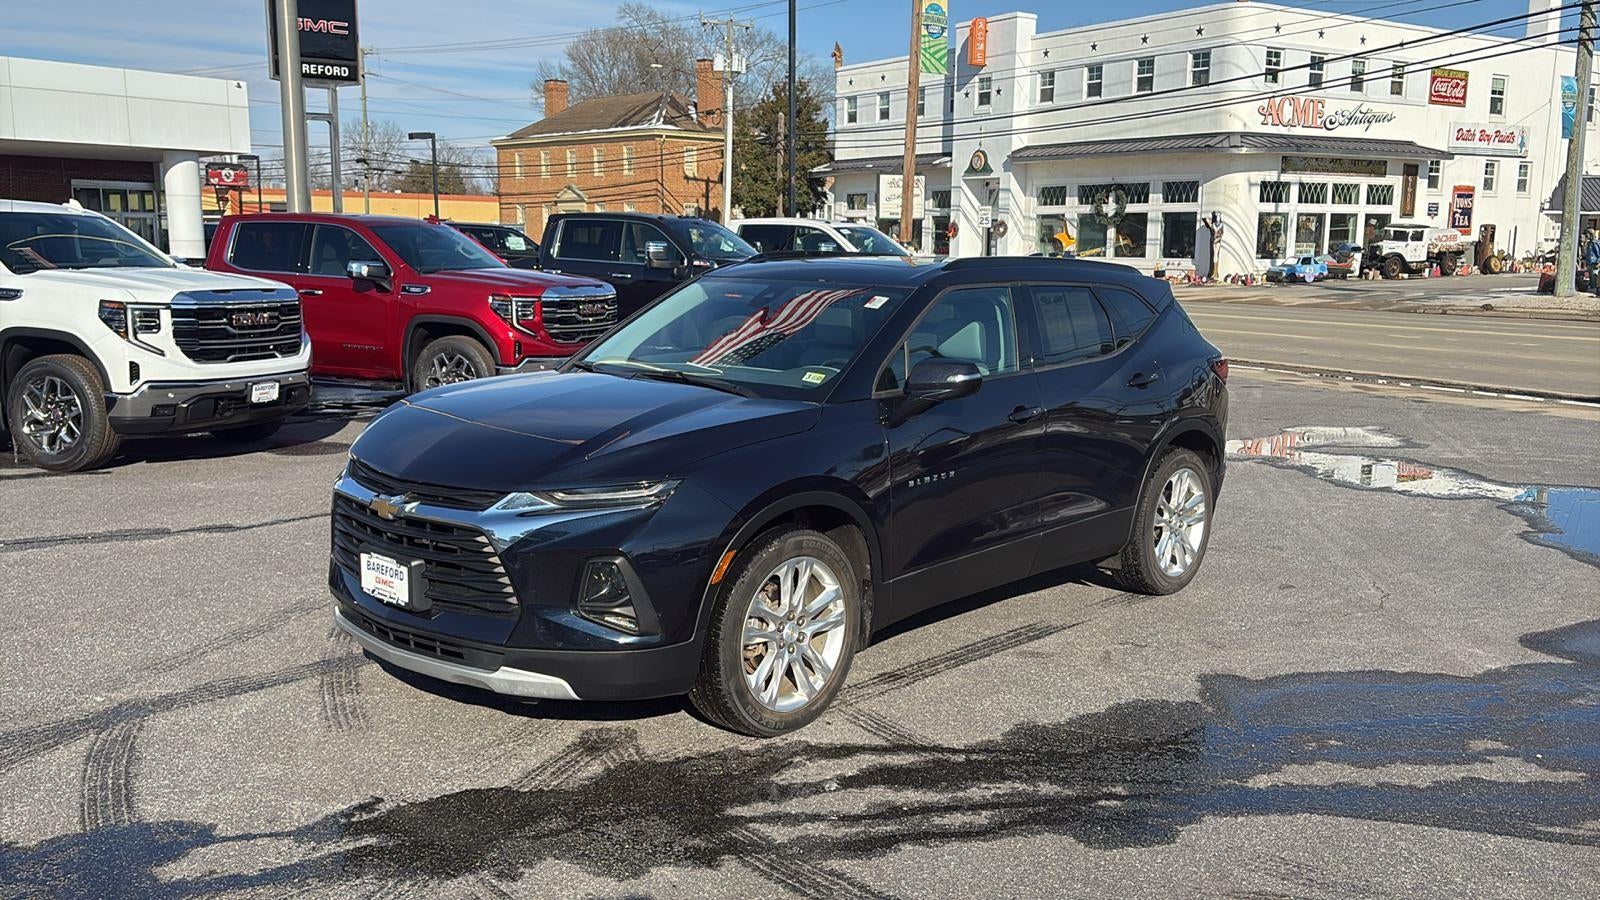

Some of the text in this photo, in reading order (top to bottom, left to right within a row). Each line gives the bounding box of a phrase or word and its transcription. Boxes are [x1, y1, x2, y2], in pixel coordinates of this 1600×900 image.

[297, 17, 349, 35] MC
[976, 21, 984, 63] ACME
[302, 63, 349, 77] REFORD
[1258, 96, 1326, 129] ACME
[1340, 103, 1397, 132] Antiques
[1456, 127, 1516, 145] Dutch Boy Paints
[979, 216, 990, 225] 25
[1454, 213, 1469, 226] TEA
[908, 470, 955, 488] BLAZER
[366, 560, 405, 582] BAREFORD
[375, 576, 395, 589] GMC
[745, 704, 785, 729] NEXEN
